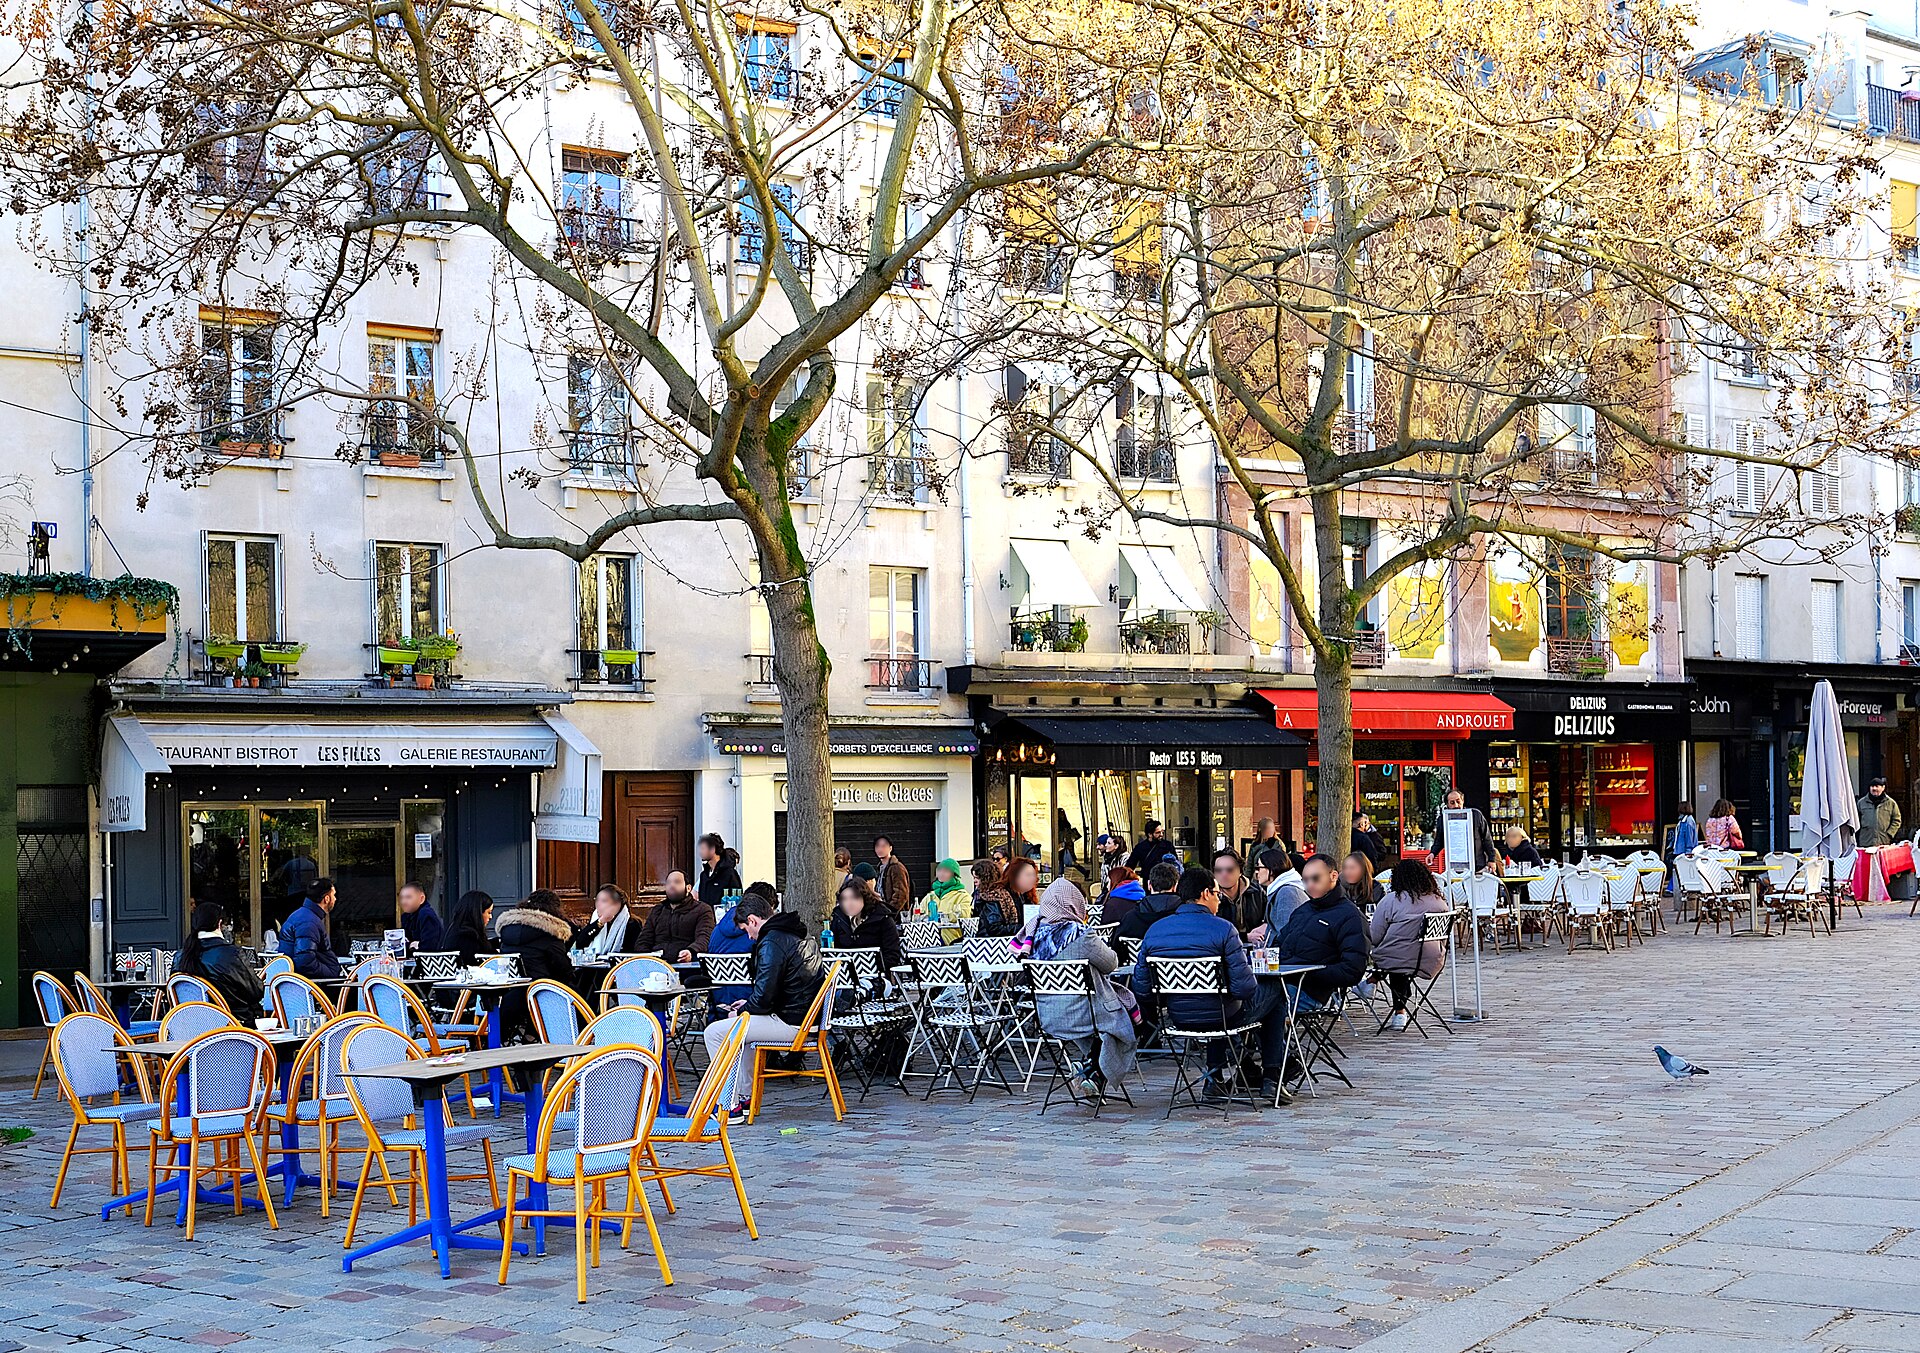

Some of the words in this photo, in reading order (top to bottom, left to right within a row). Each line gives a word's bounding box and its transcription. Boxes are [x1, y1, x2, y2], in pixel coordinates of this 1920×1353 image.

[1570, 697, 1606, 710] DELIZIUS
[1838, 700, 1882, 714] rForever
[1283, 712, 1293, 727] A
[1437, 714, 1507, 728] ANDROUET
[1555, 716, 1615, 735] DELIZIUS
[156, 746, 231, 759] STAURANT
[236, 747, 298, 759] BISTROT
[318, 746, 338, 761] LES
[343, 747, 381, 762] FILLES
[400, 748, 457, 760] GALERIE
[461, 748, 547, 760] RESTAURANT
[871, 744, 933, 753] D'EXCELLENCE
[1176, 751, 1189, 765] LES
[1190, 752, 1195, 765] 5
[1201, 751, 1222, 765] Bistro
[868, 790, 883, 802] des
[888, 782, 934, 802] Glaces
